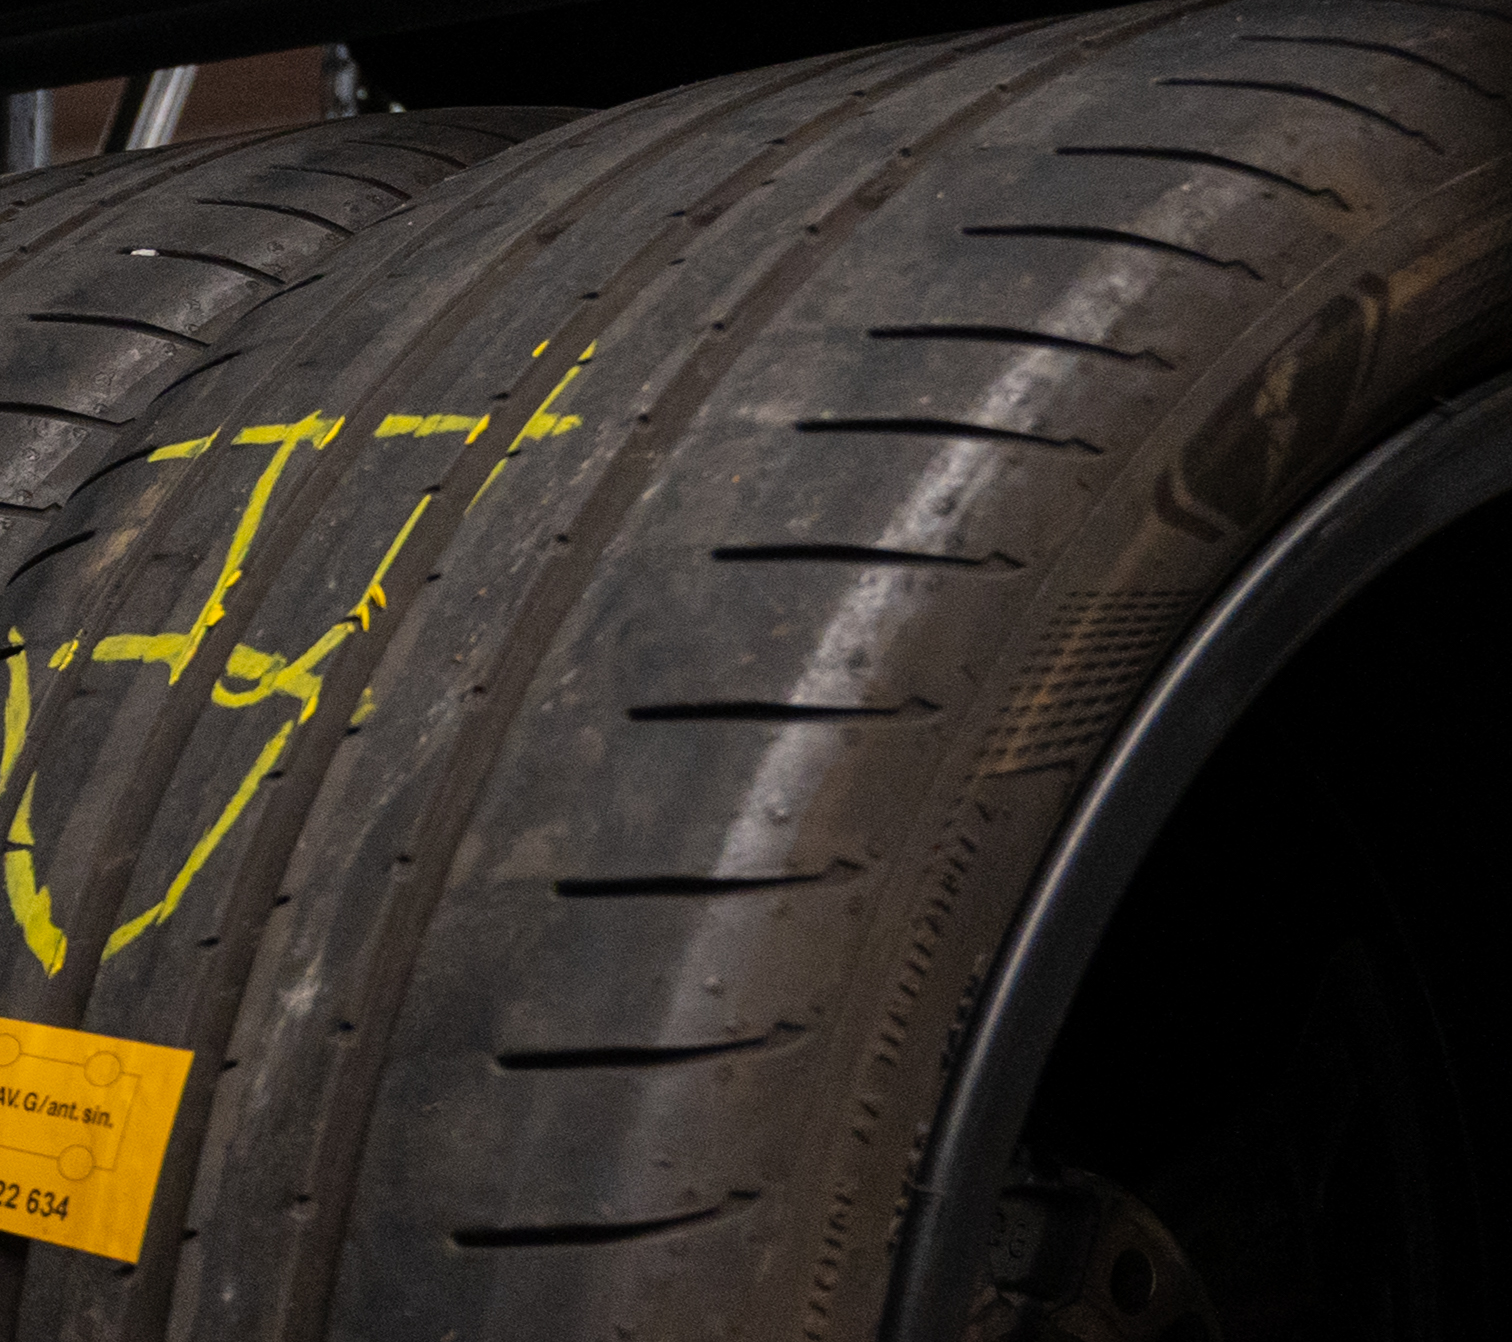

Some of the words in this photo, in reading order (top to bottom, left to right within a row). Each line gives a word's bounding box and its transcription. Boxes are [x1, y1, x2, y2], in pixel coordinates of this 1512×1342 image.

[22, 1090, 78, 1121] G/ant.
[83, 1104, 114, 1129] sin.
[25, 1188, 70, 1221] 634
